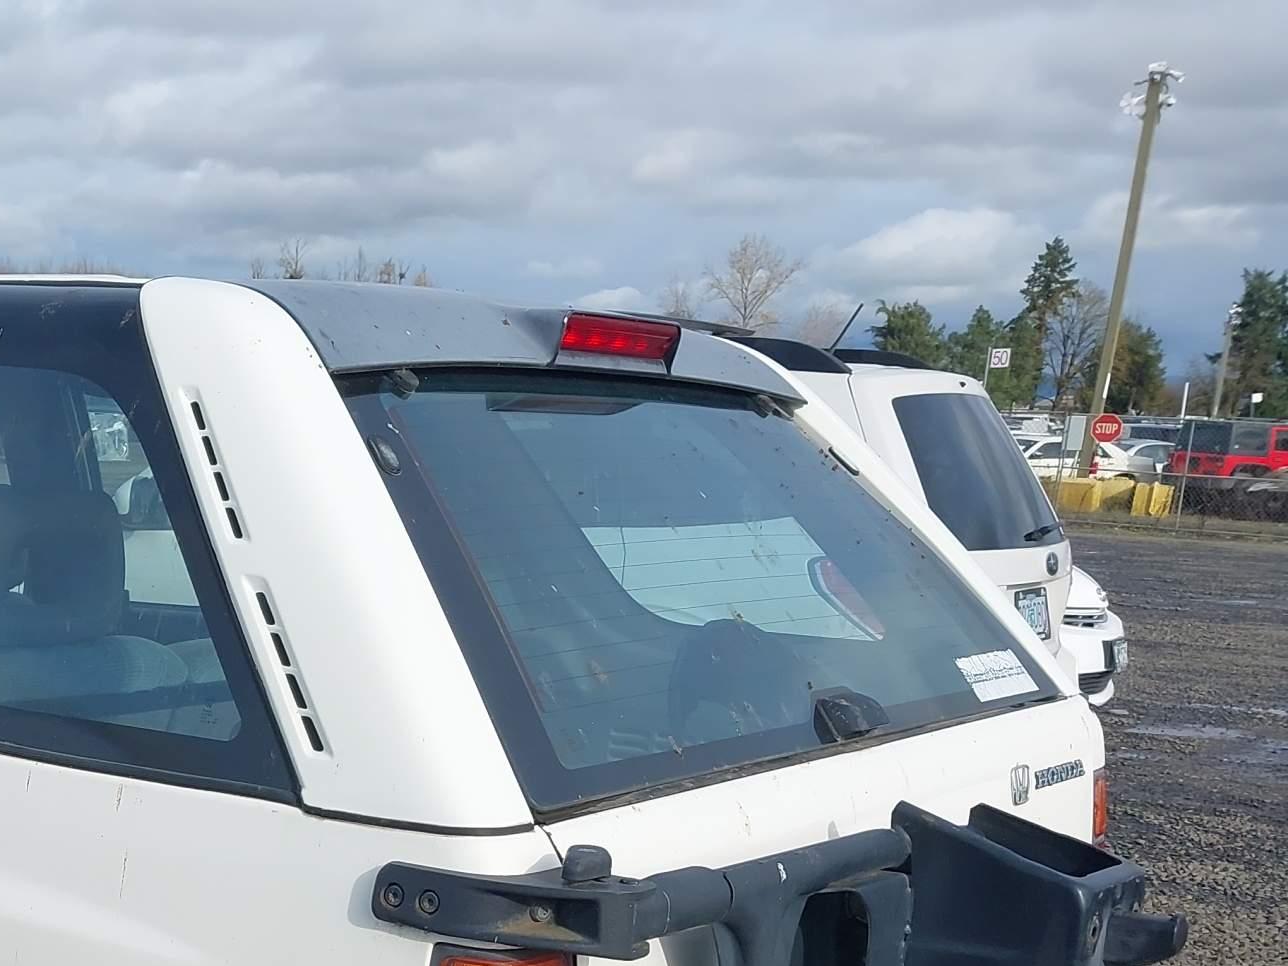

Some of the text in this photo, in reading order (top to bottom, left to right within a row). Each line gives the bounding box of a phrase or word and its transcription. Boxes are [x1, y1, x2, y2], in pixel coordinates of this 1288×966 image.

[992, 350, 1009, 366] 50
[1095, 422, 1119, 435] STOP
[1035, 759, 1085, 789] HONDA
